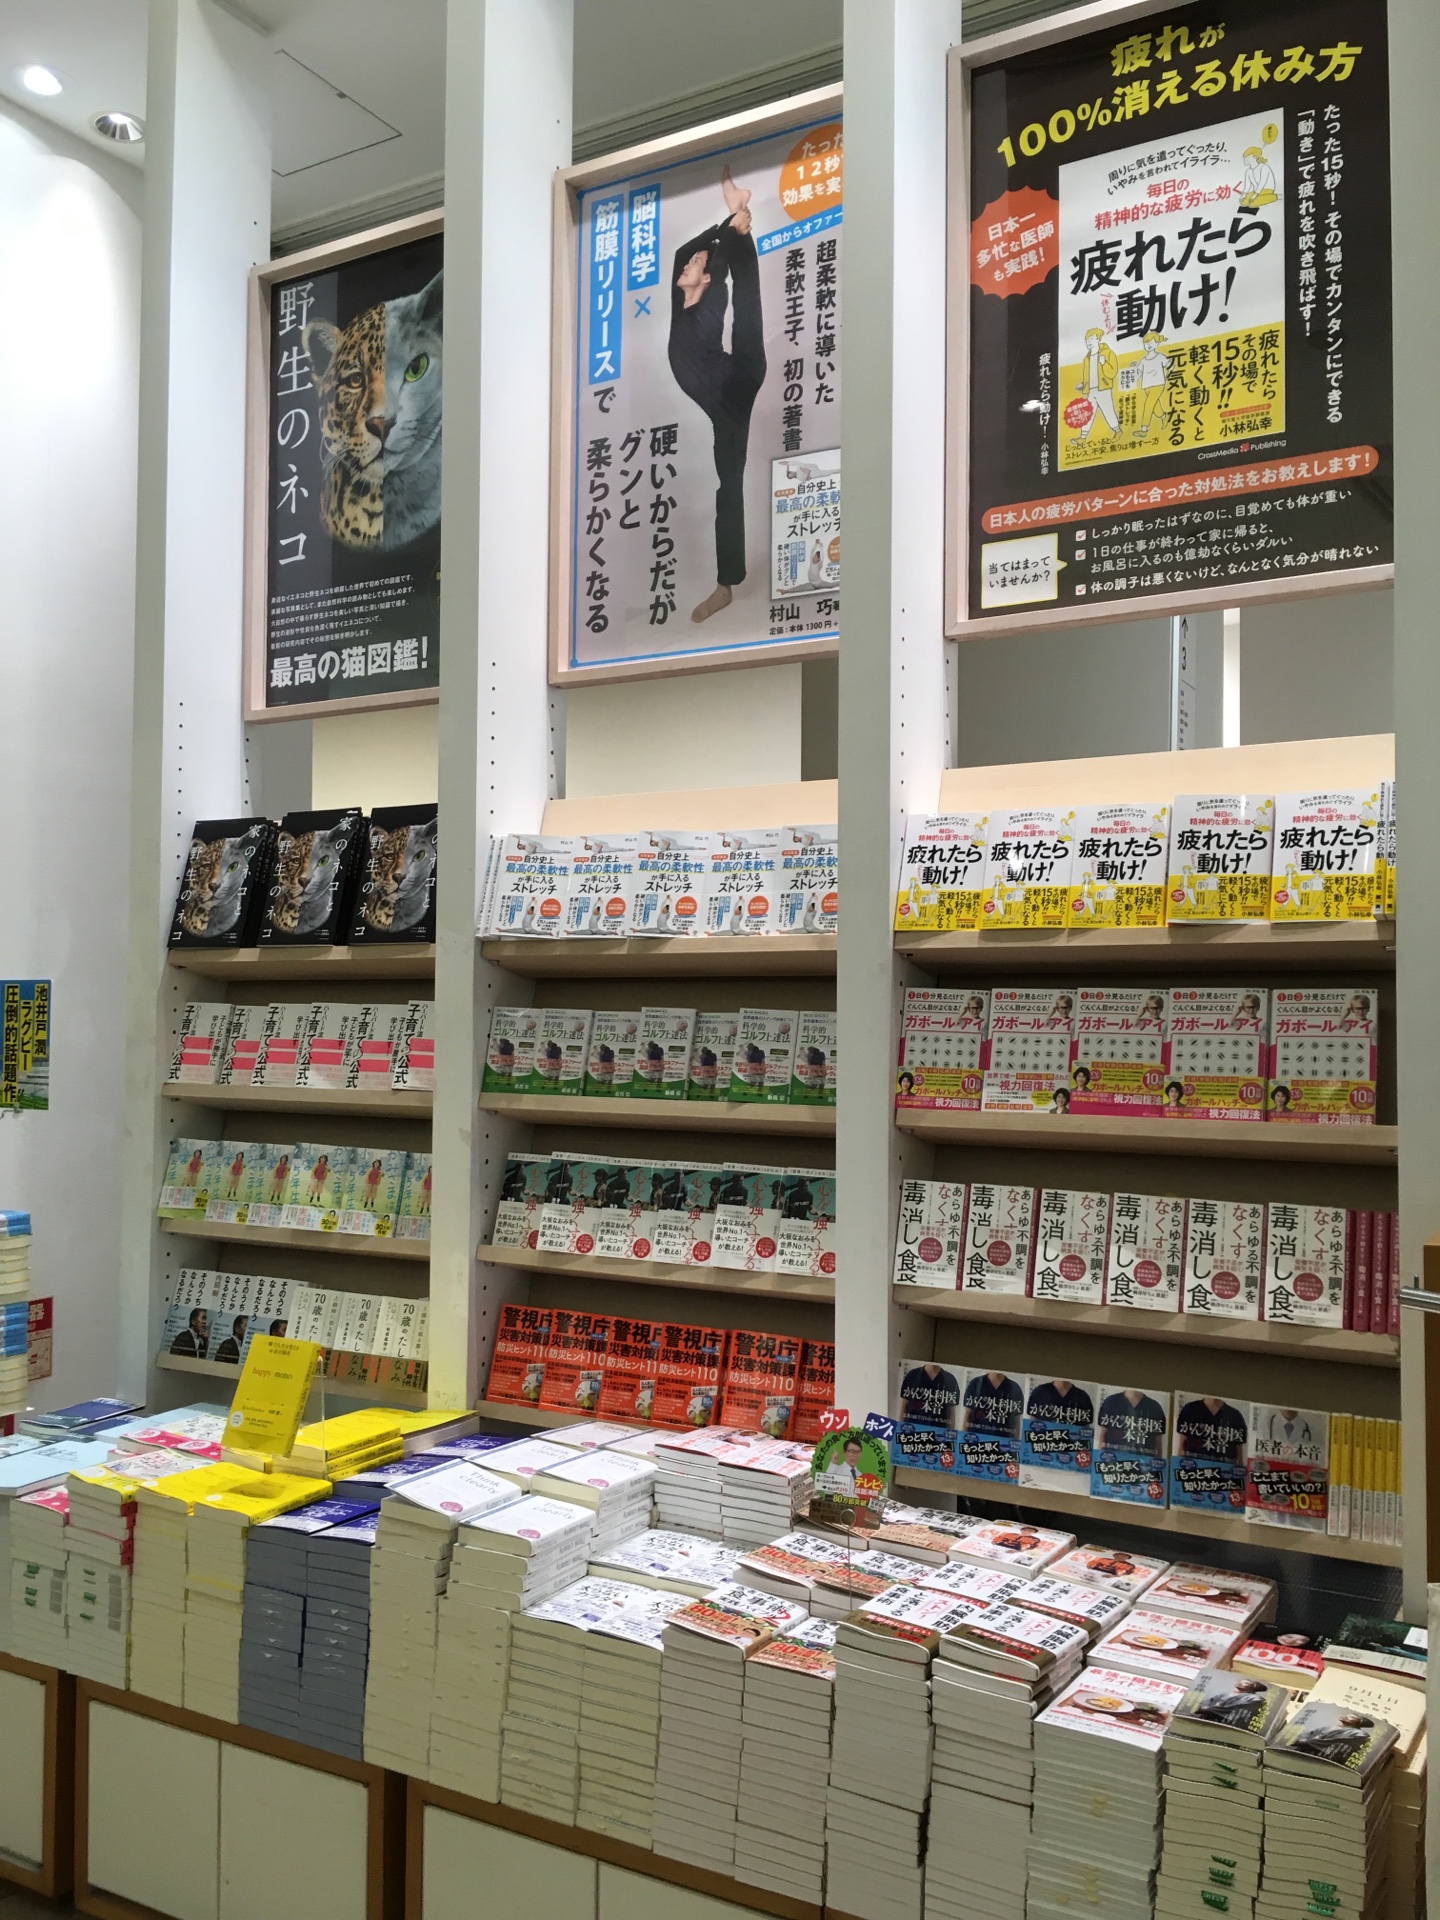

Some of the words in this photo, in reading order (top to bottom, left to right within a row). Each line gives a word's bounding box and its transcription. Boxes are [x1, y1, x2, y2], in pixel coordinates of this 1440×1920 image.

[1110, 22, 1226, 78] 疲れが
[997, 41, 1364, 169] 100%消える休み方
[1146, 178, 1190, 199] 毎日の
[1094, 180, 1243, 231] 精神的な疲労に効く
[986, 211, 1037, 243] 日本一
[1297, 107, 1318, 338] 「動き」で疲れを吹き飛ばす！
[631, 190, 657, 284] 脳科学
[976, 219, 1055, 269] 多忙な医師
[1070, 204, 1273, 296] 疲れたら
[993, 248, 1046, 283] も実践！
[1322, 104, 1346, 424] たった15秒！その場でカンタンにできる
[592, 201, 620, 414] 筋膜リリースで
[1115, 266, 1236, 344] 動け！
[815, 239, 838, 405] 超柔軟に導いた
[782, 247, 805, 452] 柔軟王子、初の著書
[1241, 333, 1260, 394] その場で
[1259, 329, 1280, 401] 疲れたら
[1166, 347, 1188, 446] 元気になる
[1188, 344, 1211, 442] 軽く動くと
[276, 281, 316, 567] 野生のネコ
[1219, 416, 1273, 438] 小林弘幸
[1197, 446, 1239, 460] CrossMedia
[1250, 438, 1288, 452] Publishing
[619, 428, 645, 530] グンと
[797, 479, 837, 495] 自分史上
[989, 451, 1372, 529] 日本人の疲労パターンに合った対処法をお教えします！
[649, 422, 679, 626] 硬いからだが
[793, 507, 840, 524] が手に入る
[1090, 487, 1353, 540] しっかり眠ったはずなのに、目覚めても体が重い
[585, 437, 612, 634] 柔らかくなる
[1090, 523, 1275, 559] 1日の仕事が終わって家に帰ると、
[988, 555, 1051, 576] 当てはまって
[1090, 533, 1294, 575] お風呂に入るのも億劫なくらいダルい
[988, 570, 1052, 590] いませんか？
[1090, 543, 1380, 597] 体の調子は悪くないけど、なんとなく気分が晴れない
[769, 604, 801, 623] 村山
[269, 635, 429, 689] 最高の猫図鑑！
[1078, 836, 1163, 859] 疲れたら
[1176, 827, 1269, 852] 疲れたら
[1280, 824, 1375, 850] 疲れたら
[326, 816, 352, 912] 家のネコと
[524, 855, 555, 865] 自分史上
[712, 859, 776, 873] 最高の柔軟性
[907, 843, 983, 865] 疲れたら
[1197, 852, 1252, 875] 動け！
[1300, 848, 1358, 873] 動け！
[505, 862, 570, 876] 最高の柔軟性
[921, 865, 968, 886] 動け！
[1096, 859, 1148, 882] 動け！
[172, 845, 203, 941] 野生のネコ
[262, 839, 291, 938] 野生のネコ
[354, 834, 385, 937] 野生のネコ
[510, 882, 557, 895] ストレッチ
[717, 880, 765, 894] ストレッチ
[1277, 991, 1347, 1002] 1日3分見るだけで
[742, 1021, 766, 1031] 科学的
[905, 1015, 985, 1031] ガボール・アイ
[992, 1017, 1075, 1031] ガボール・アイ
[1171, 1017, 1264, 1032] ガボール・アイ
[1275, 1019, 1374, 1034] ガボール・アイ
[3, 984, 19, 1103] 圧倒的話題作
[21, 1001, 32, 1071] ラグビー
[740, 1030, 791, 1044] ゴルフ上達法
[999, 1080, 1056, 1092] 視力回復法
[1318, 1113, 1374, 1126] 視力回復法
[1230, 1204, 1249, 1258] なくす
[250, 1278, 266, 1323] なるだろう
[262, 1279, 277, 1316] なんとか
[275, 1280, 289, 1317] そのうち
[664, 1324, 723, 1351] 警視庁
[734, 1331, 799, 1359] 警視庁
[661, 1347, 719, 1369] 災害対策課
[731, 1355, 796, 1378] 災害対策課
[659, 1362, 718, 1382] 防災ヒント110
[729, 1370, 795, 1392] 防災ヒント110
[903, 1386, 957, 1405] がん外科医
[819, 1410, 848, 1430] ウソ
[864, 1417, 895, 1439] ホント
[1179, 1420, 1245, 1443] がん外科医
[609, 1453, 640, 1467] Think
[1255, 1437, 1322, 1461] 医者の本音
[459, 1474, 500, 1495] clearly
[469, 1471, 502, 1488] Think
